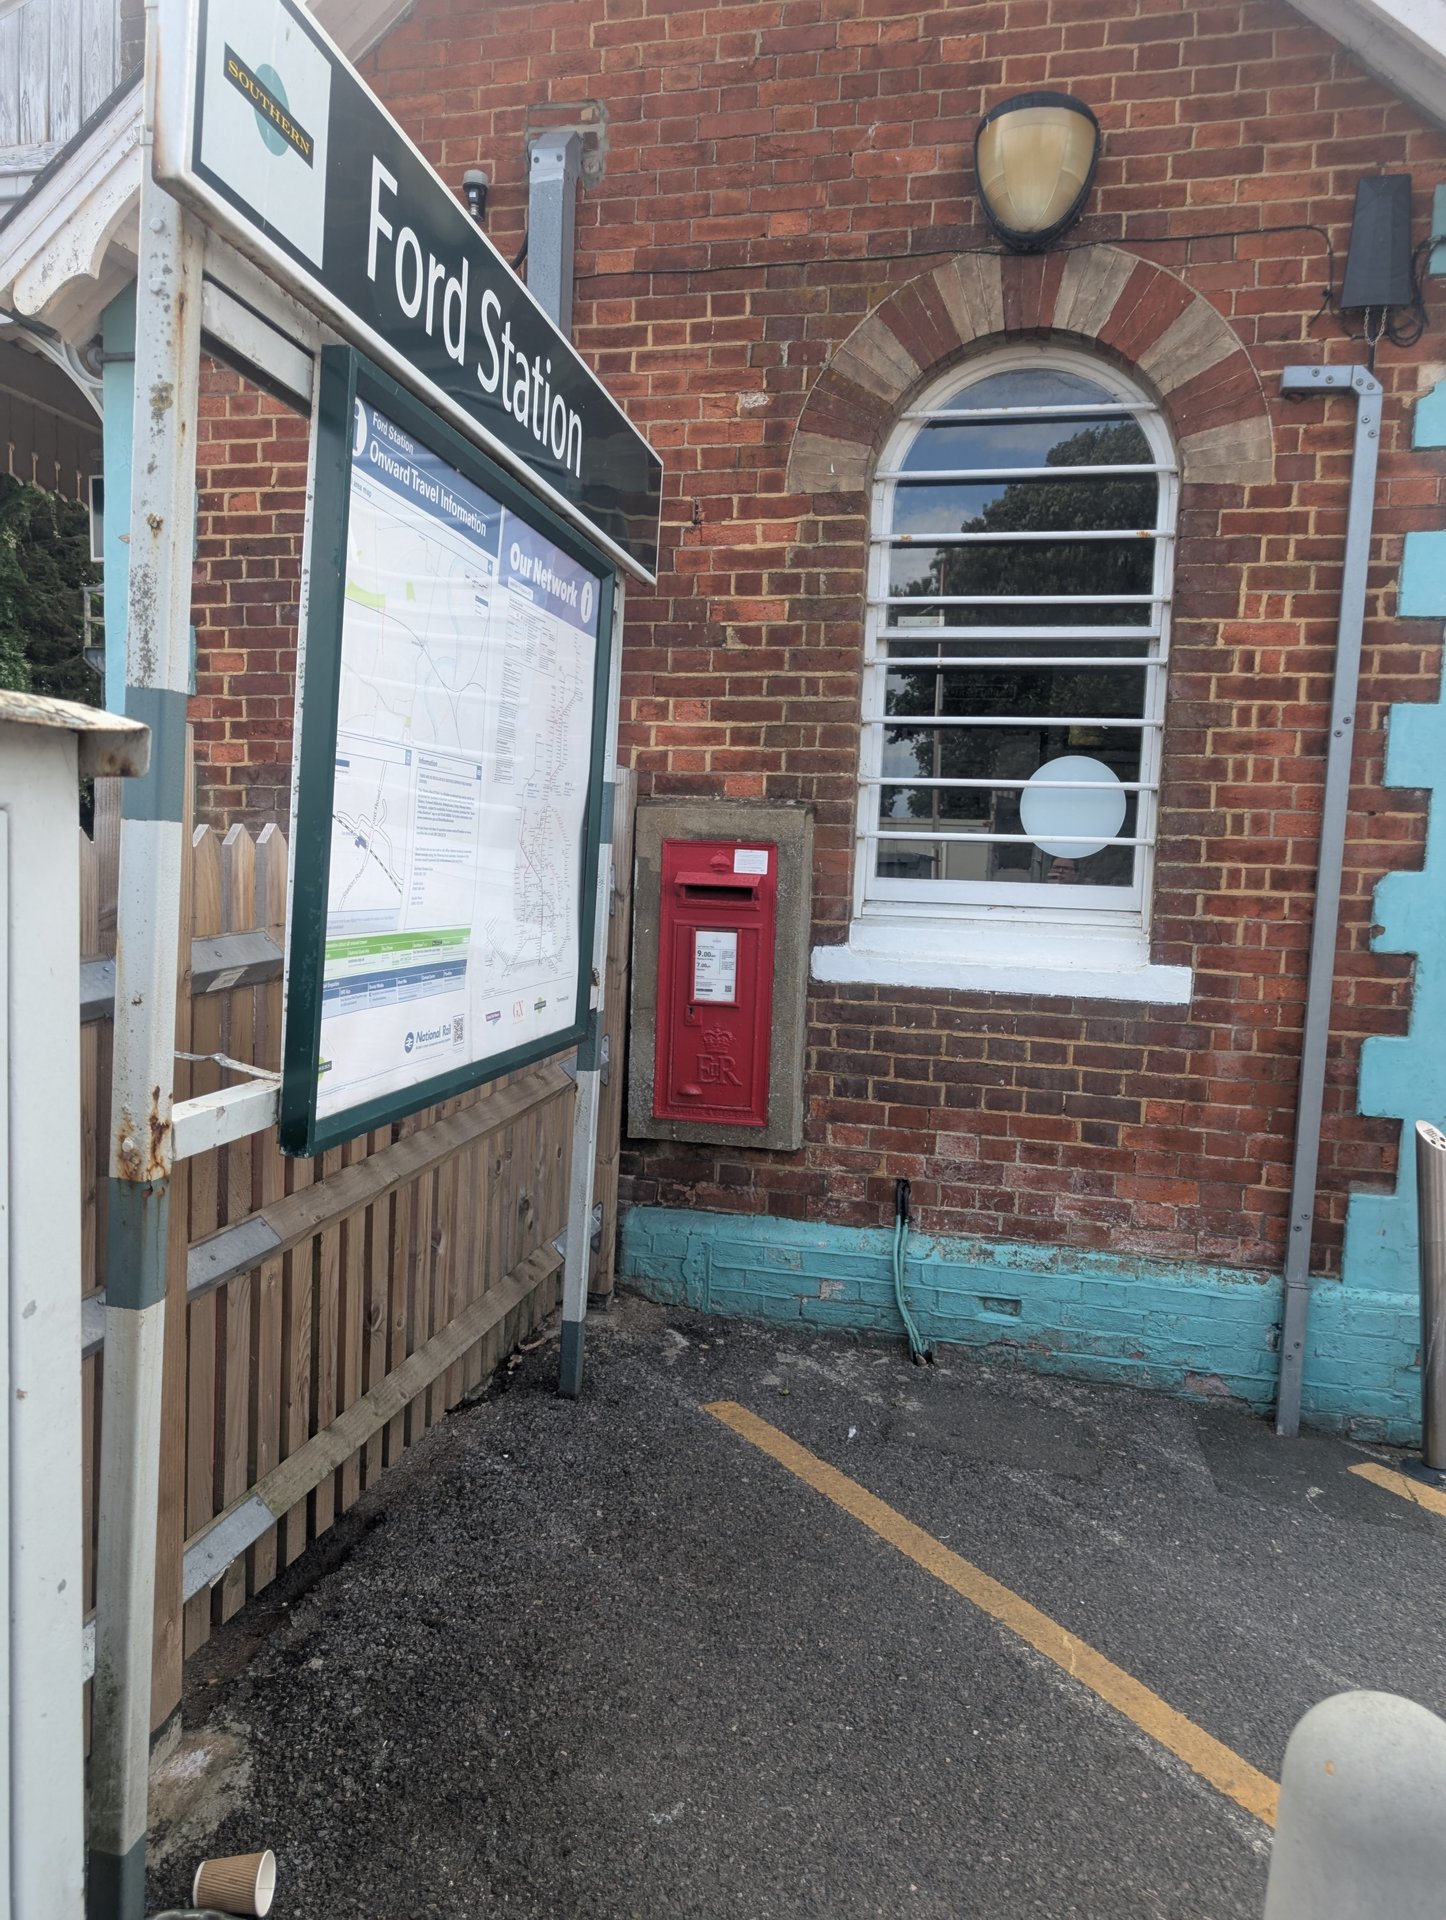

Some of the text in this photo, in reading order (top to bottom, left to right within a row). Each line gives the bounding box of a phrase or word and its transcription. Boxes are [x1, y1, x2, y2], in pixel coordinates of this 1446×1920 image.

[228, 59, 310, 155] SOUTHERN
[367, 153, 583, 479] Ford Station
[372, 411, 414, 455] Ford Station
[370, 440, 487, 537] Onward Travel Information
[510, 542, 532, 578] Our
[532, 557, 578, 608] Network
[415, 1022, 451, 1043] National Rail
